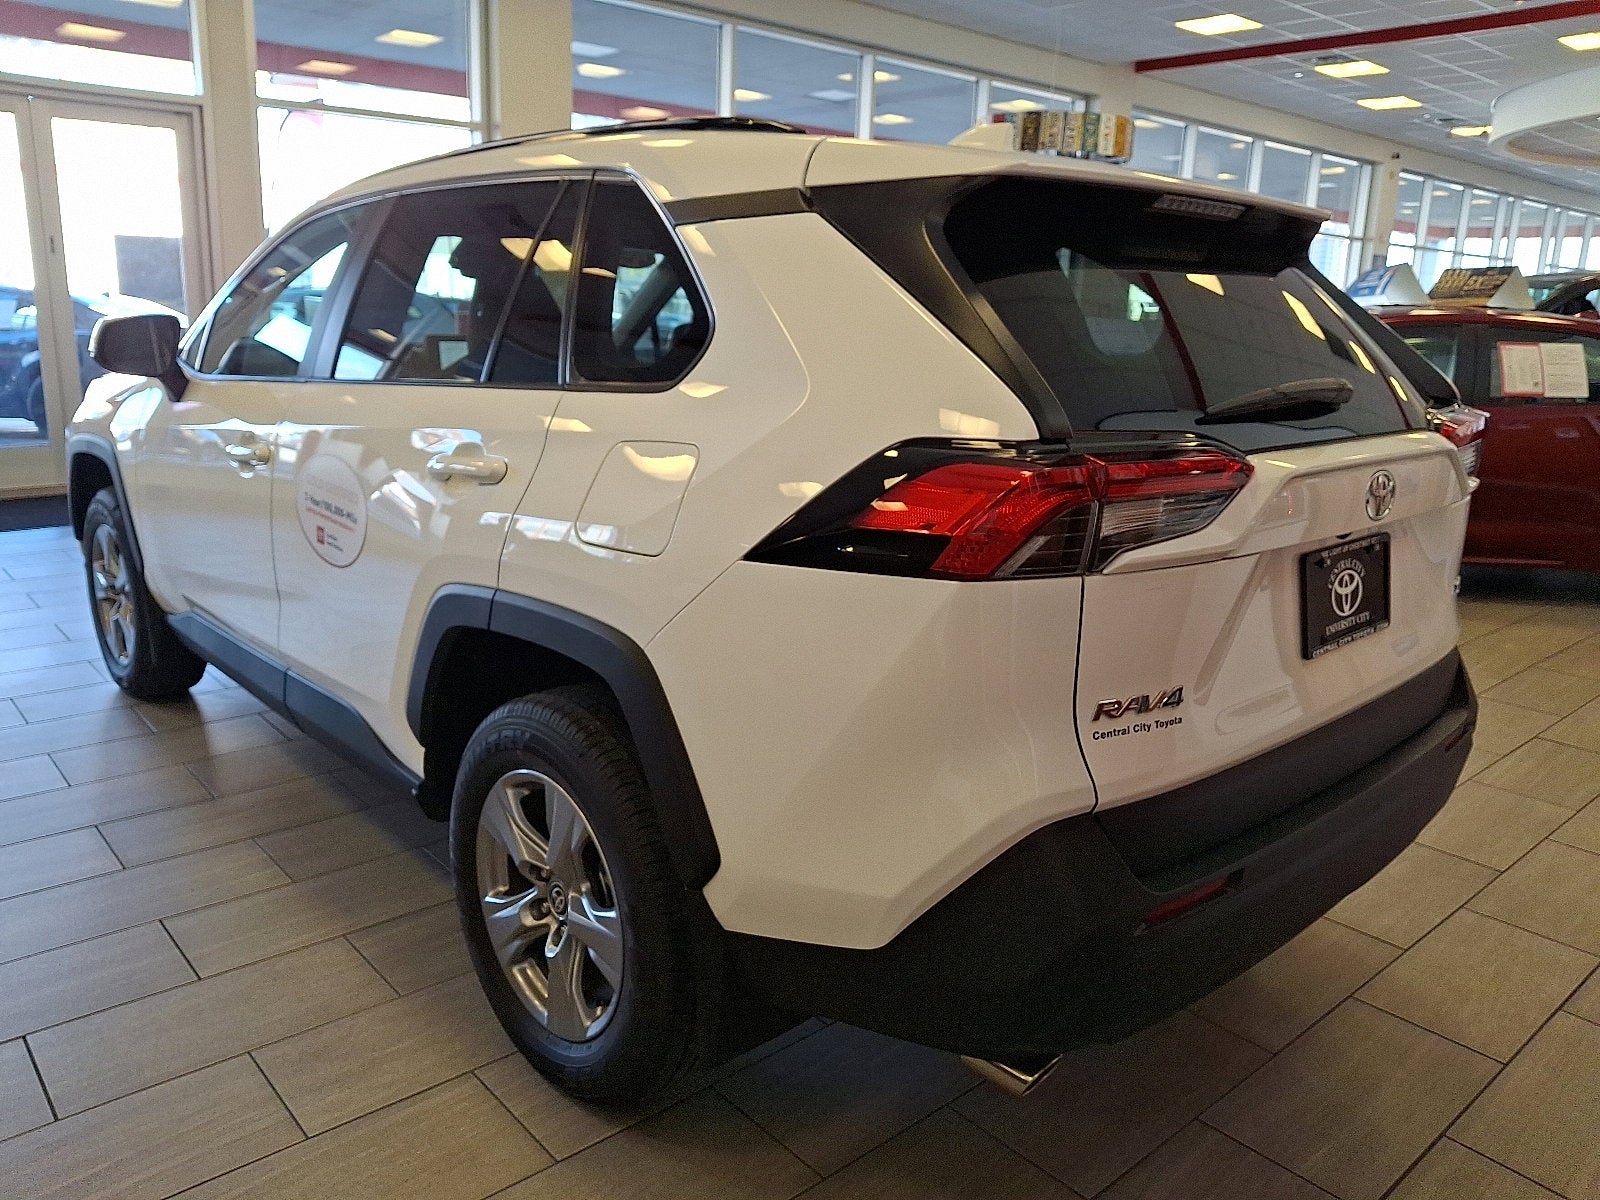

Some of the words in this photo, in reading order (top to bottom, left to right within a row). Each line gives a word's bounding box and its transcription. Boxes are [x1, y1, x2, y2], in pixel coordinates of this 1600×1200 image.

[1325, 616, 1355, 636] UNIVERSITY
[1356, 611, 1370, 624] CITY
[1092, 685, 1184, 721] RAV4
[1092, 725, 1130, 740] Central
[1133, 722, 1152, 733] City
[1154, 716, 1183, 729] Toyota
